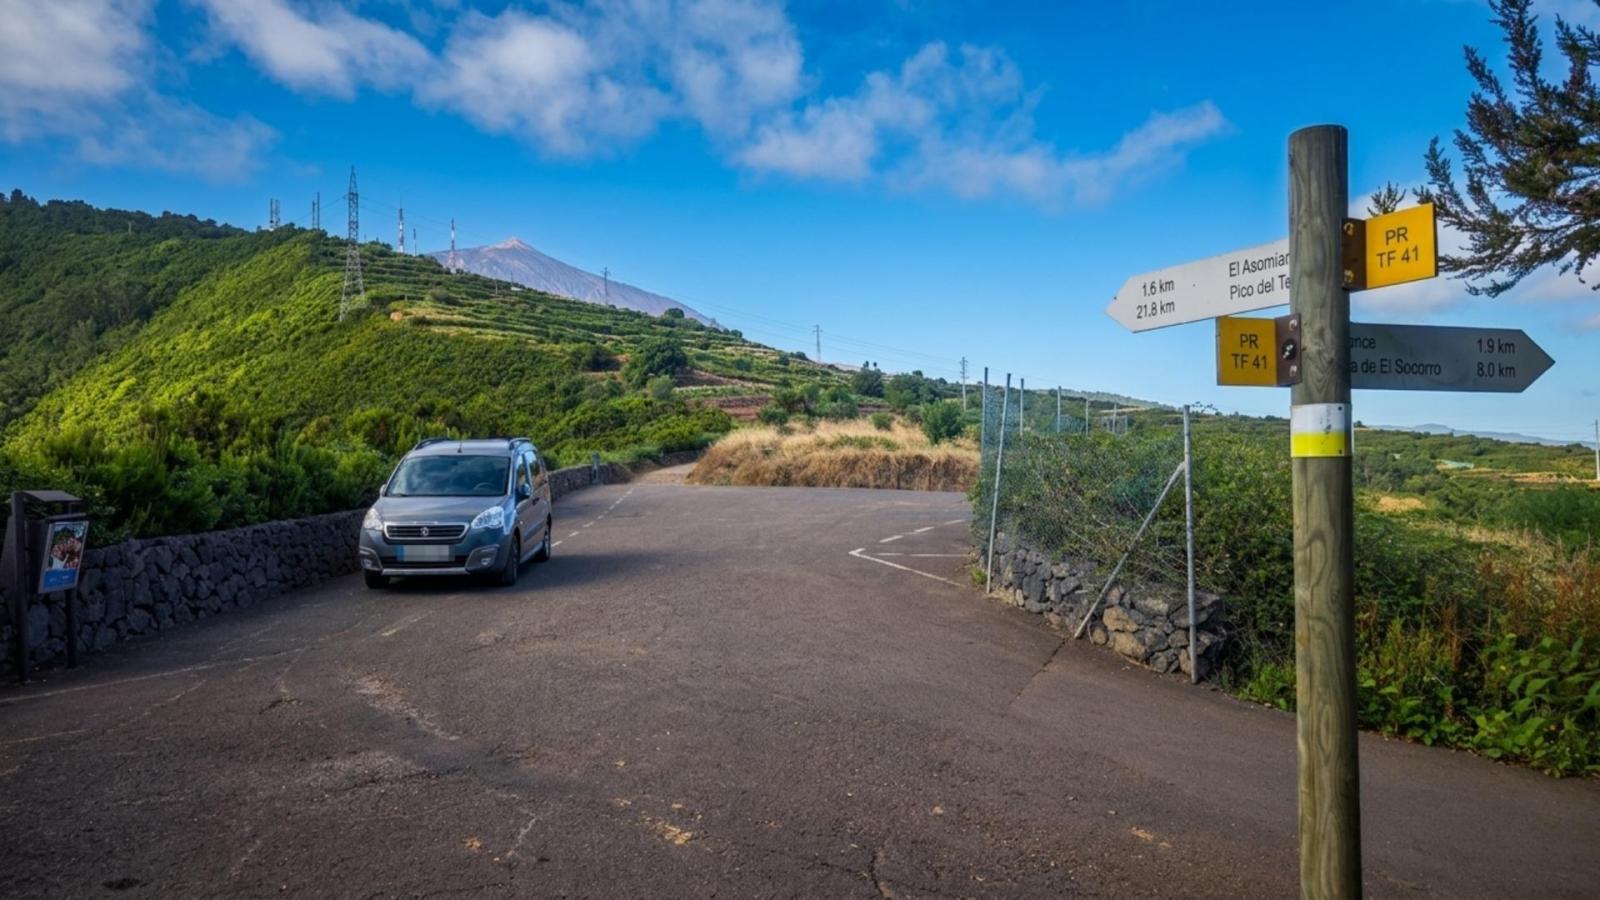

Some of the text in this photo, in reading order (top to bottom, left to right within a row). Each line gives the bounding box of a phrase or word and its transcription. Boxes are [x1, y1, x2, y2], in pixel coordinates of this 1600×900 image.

[1385, 227, 1408, 246] PR
[1376, 245, 1418, 268] TF 41
[1142, 281, 1156, 297] 1.6
[1159, 279, 1174, 294] km
[1229, 261, 1240, 277] El
[1136, 303, 1157, 319] 21.8
[1160, 301, 1175, 315] km
[1230, 284, 1254, 300] Pico
[1257, 277, 1274, 294] del
[1240, 333, 1258, 348] PR
[1477, 338, 1494, 354] 1.9
[1498, 338, 1515, 354] km
[1231, 353, 1267, 369] TF 41
[1361, 358, 1376, 374] de
[1380, 358, 1392, 374] El
[1395, 359, 1442, 376] Socorro
[1477, 362, 1495, 377] 8.0
[1498, 362, 1516, 378] km
